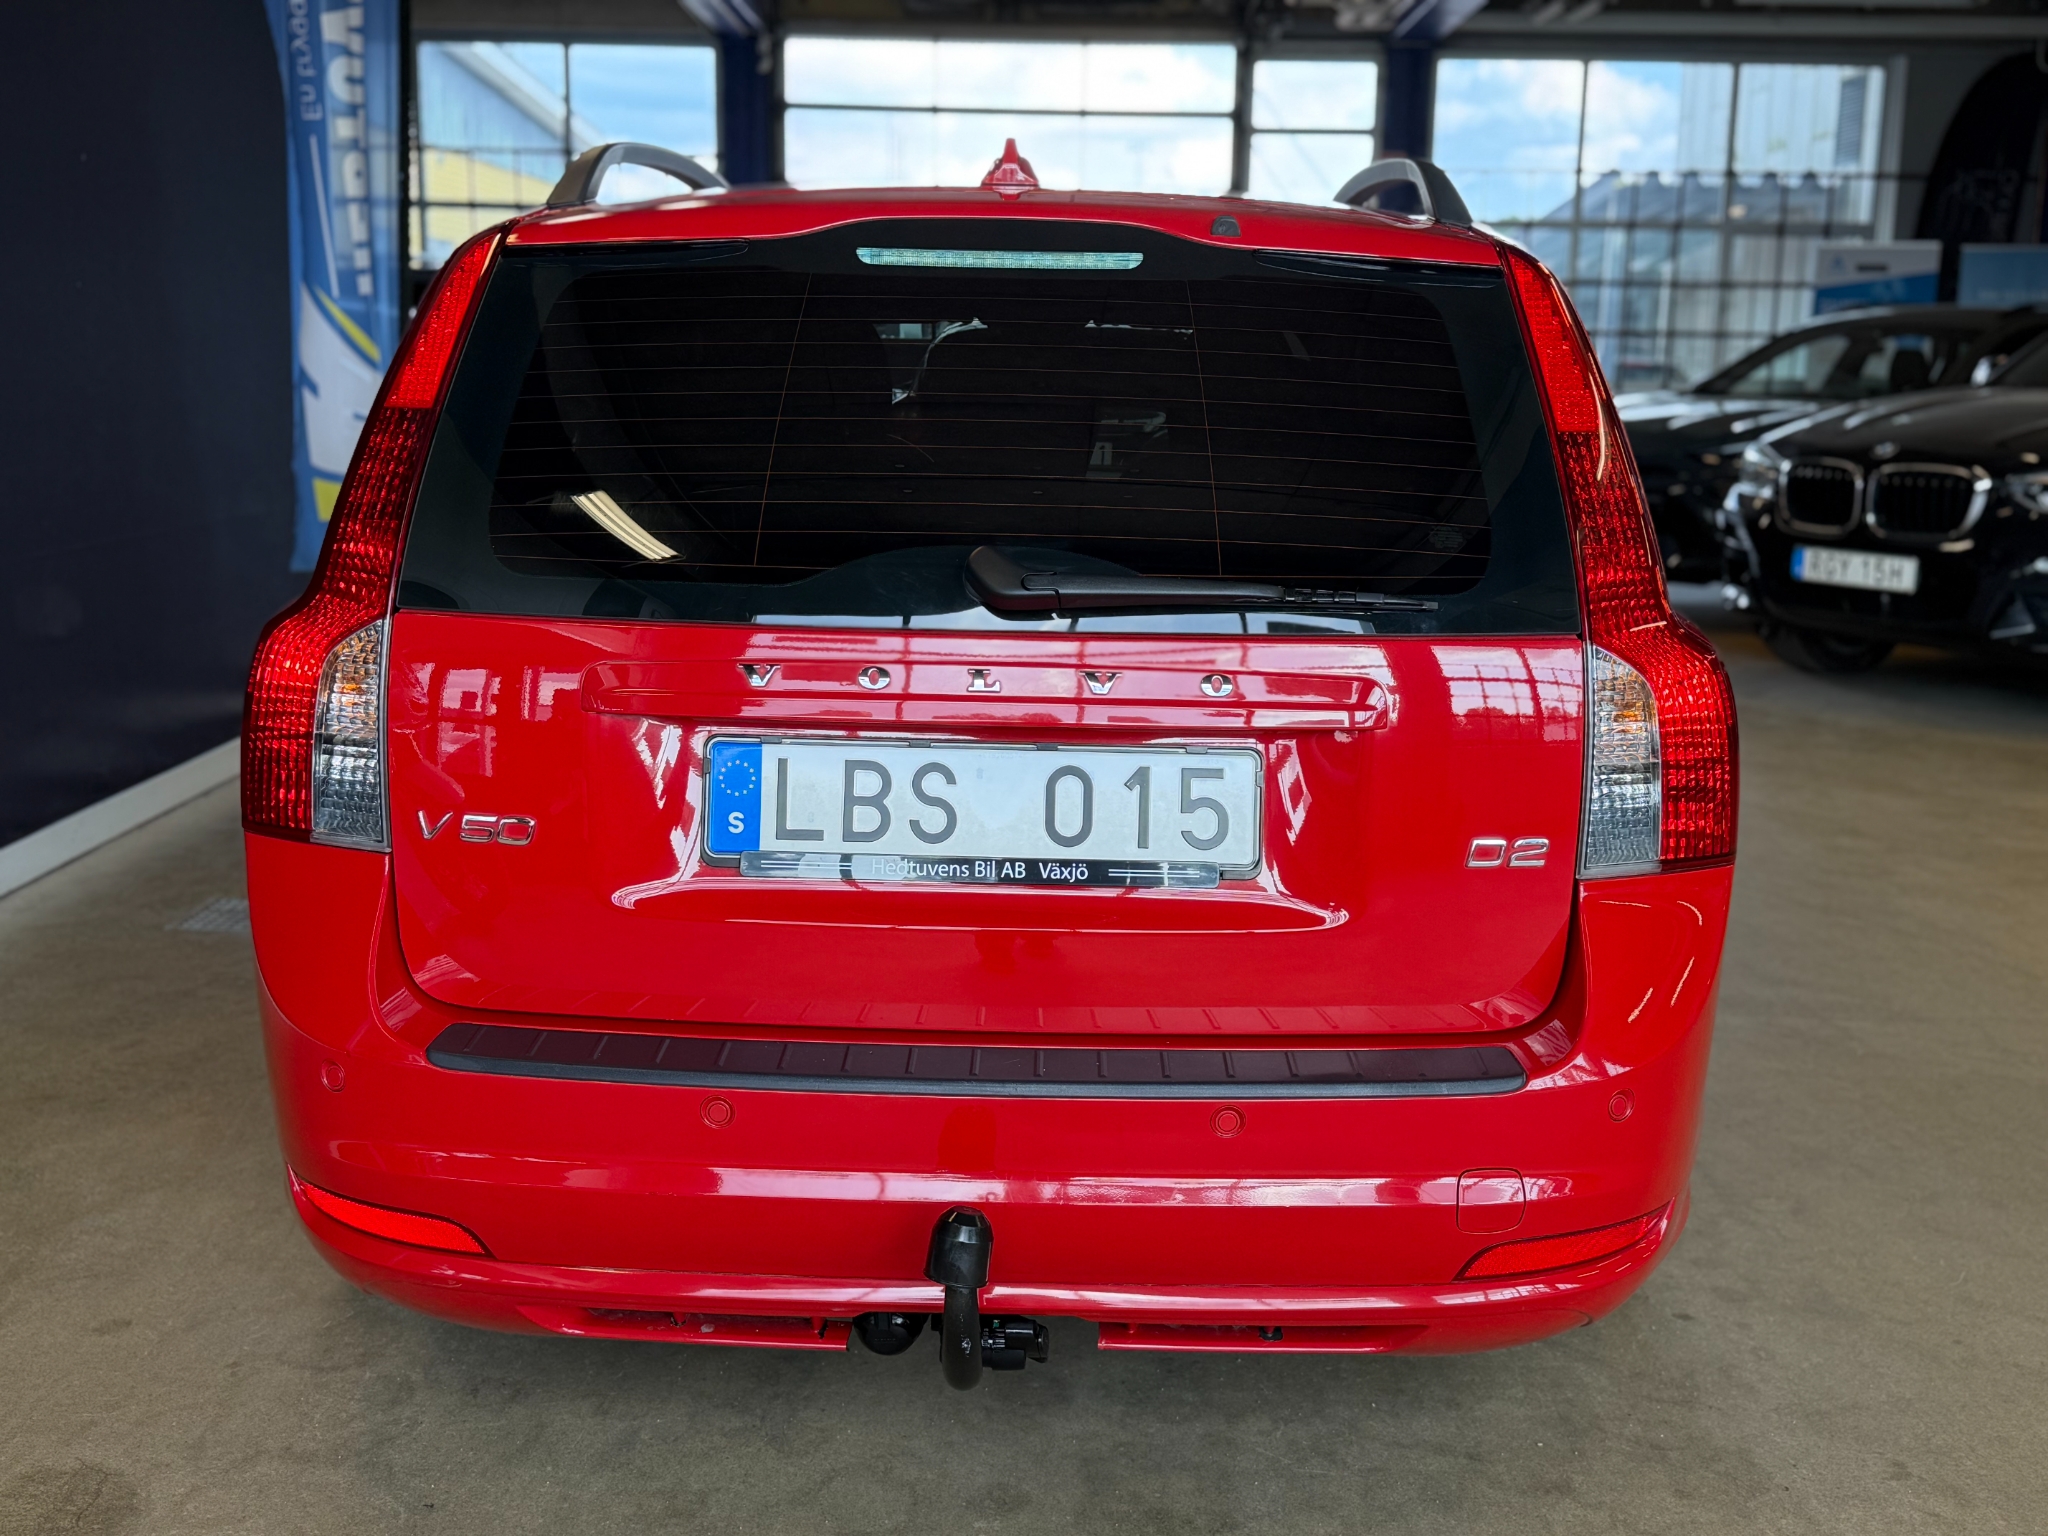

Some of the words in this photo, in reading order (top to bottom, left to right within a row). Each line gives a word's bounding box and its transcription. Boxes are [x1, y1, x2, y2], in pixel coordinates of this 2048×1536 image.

[737, 662, 1234, 697] VOLVO
[776, 757, 958, 845] LBS
[1044, 764, 1229, 851] 015
[727, 811, 745, 834] S
[1463, 837, 1550, 869] D2
[871, 858, 970, 878] Hedtuvens
[974, 859, 996, 878] Bil
[1000, 861, 1026, 879] AB
[1039, 861, 1089, 883] Växjö
